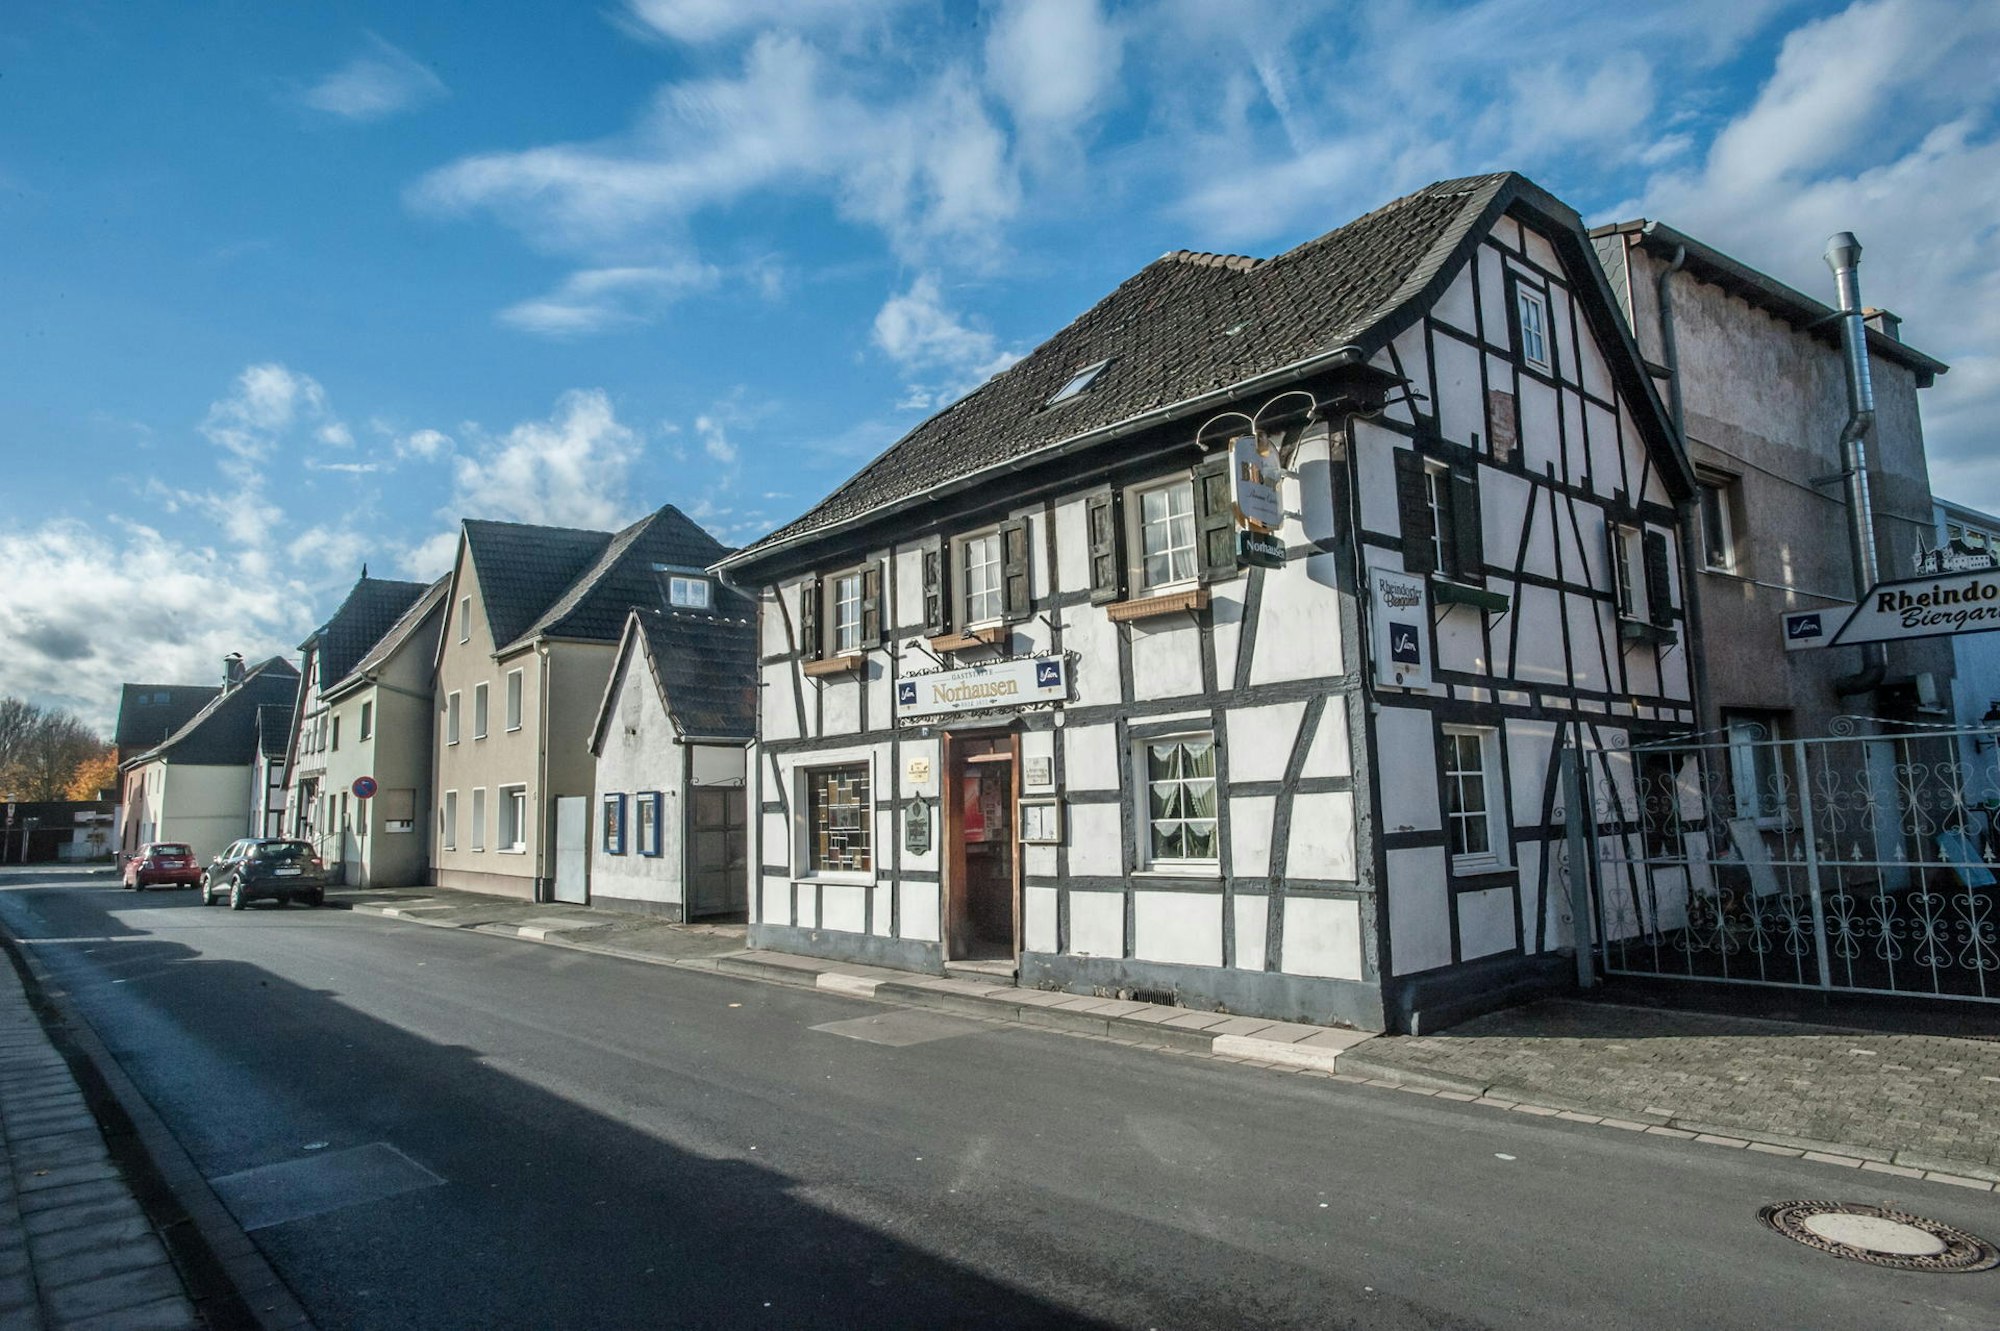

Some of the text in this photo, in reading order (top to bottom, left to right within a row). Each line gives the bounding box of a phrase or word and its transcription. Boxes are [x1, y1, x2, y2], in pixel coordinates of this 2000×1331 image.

[1877, 581, 1998, 613] Rheindo
[1901, 605, 2000, 631] Biergar
[952, 669, 993, 680] GASTSTTTE
[932, 679, 1018, 704] Norhausen
